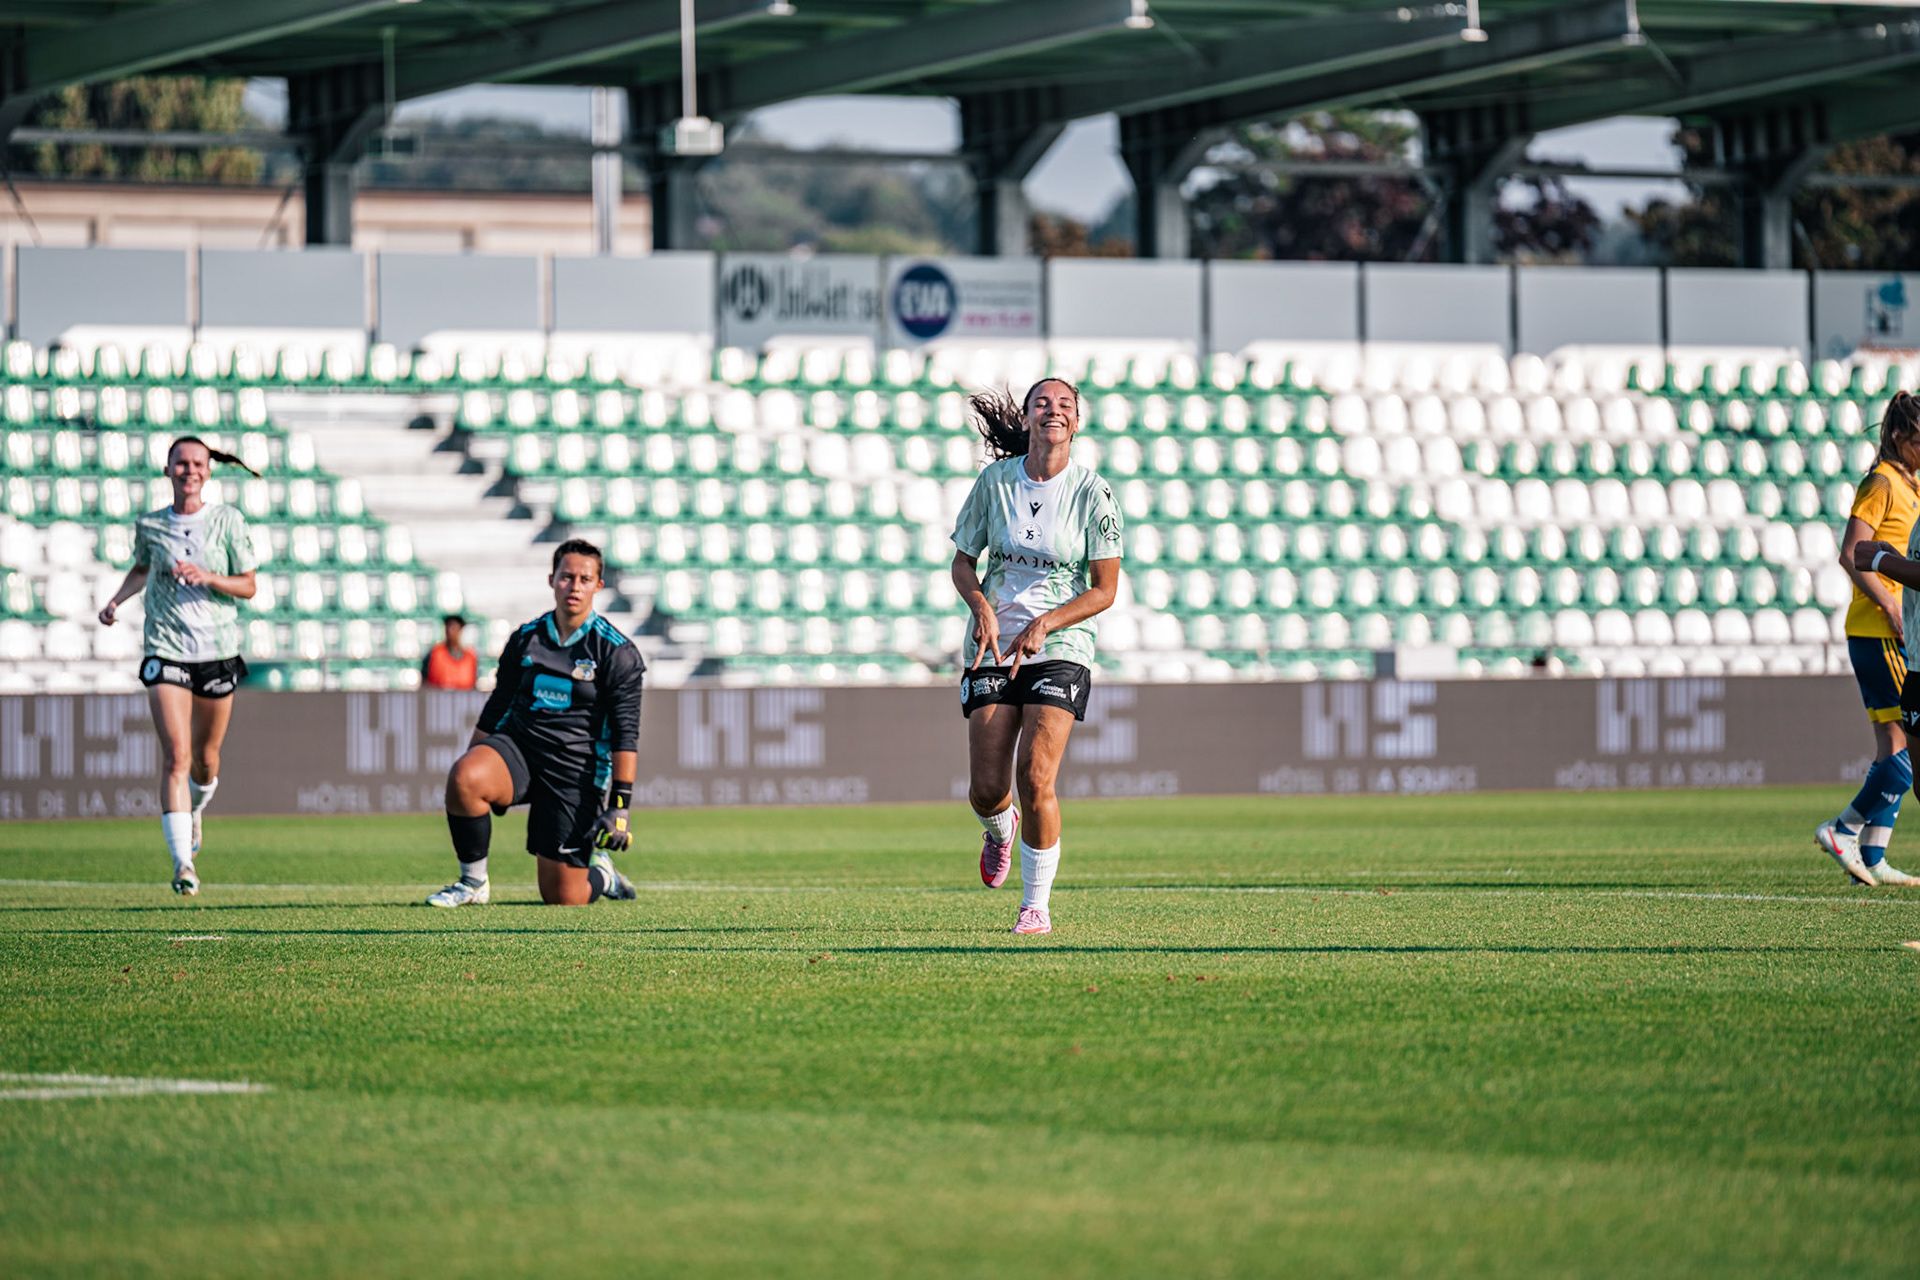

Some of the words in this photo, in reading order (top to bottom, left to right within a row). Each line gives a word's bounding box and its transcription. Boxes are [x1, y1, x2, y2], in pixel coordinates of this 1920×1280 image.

[536, 689, 568, 702] MAM
[38, 790, 65, 817] DE
[78, 789, 108, 817] LA
[115, 787, 162, 816] SOU
